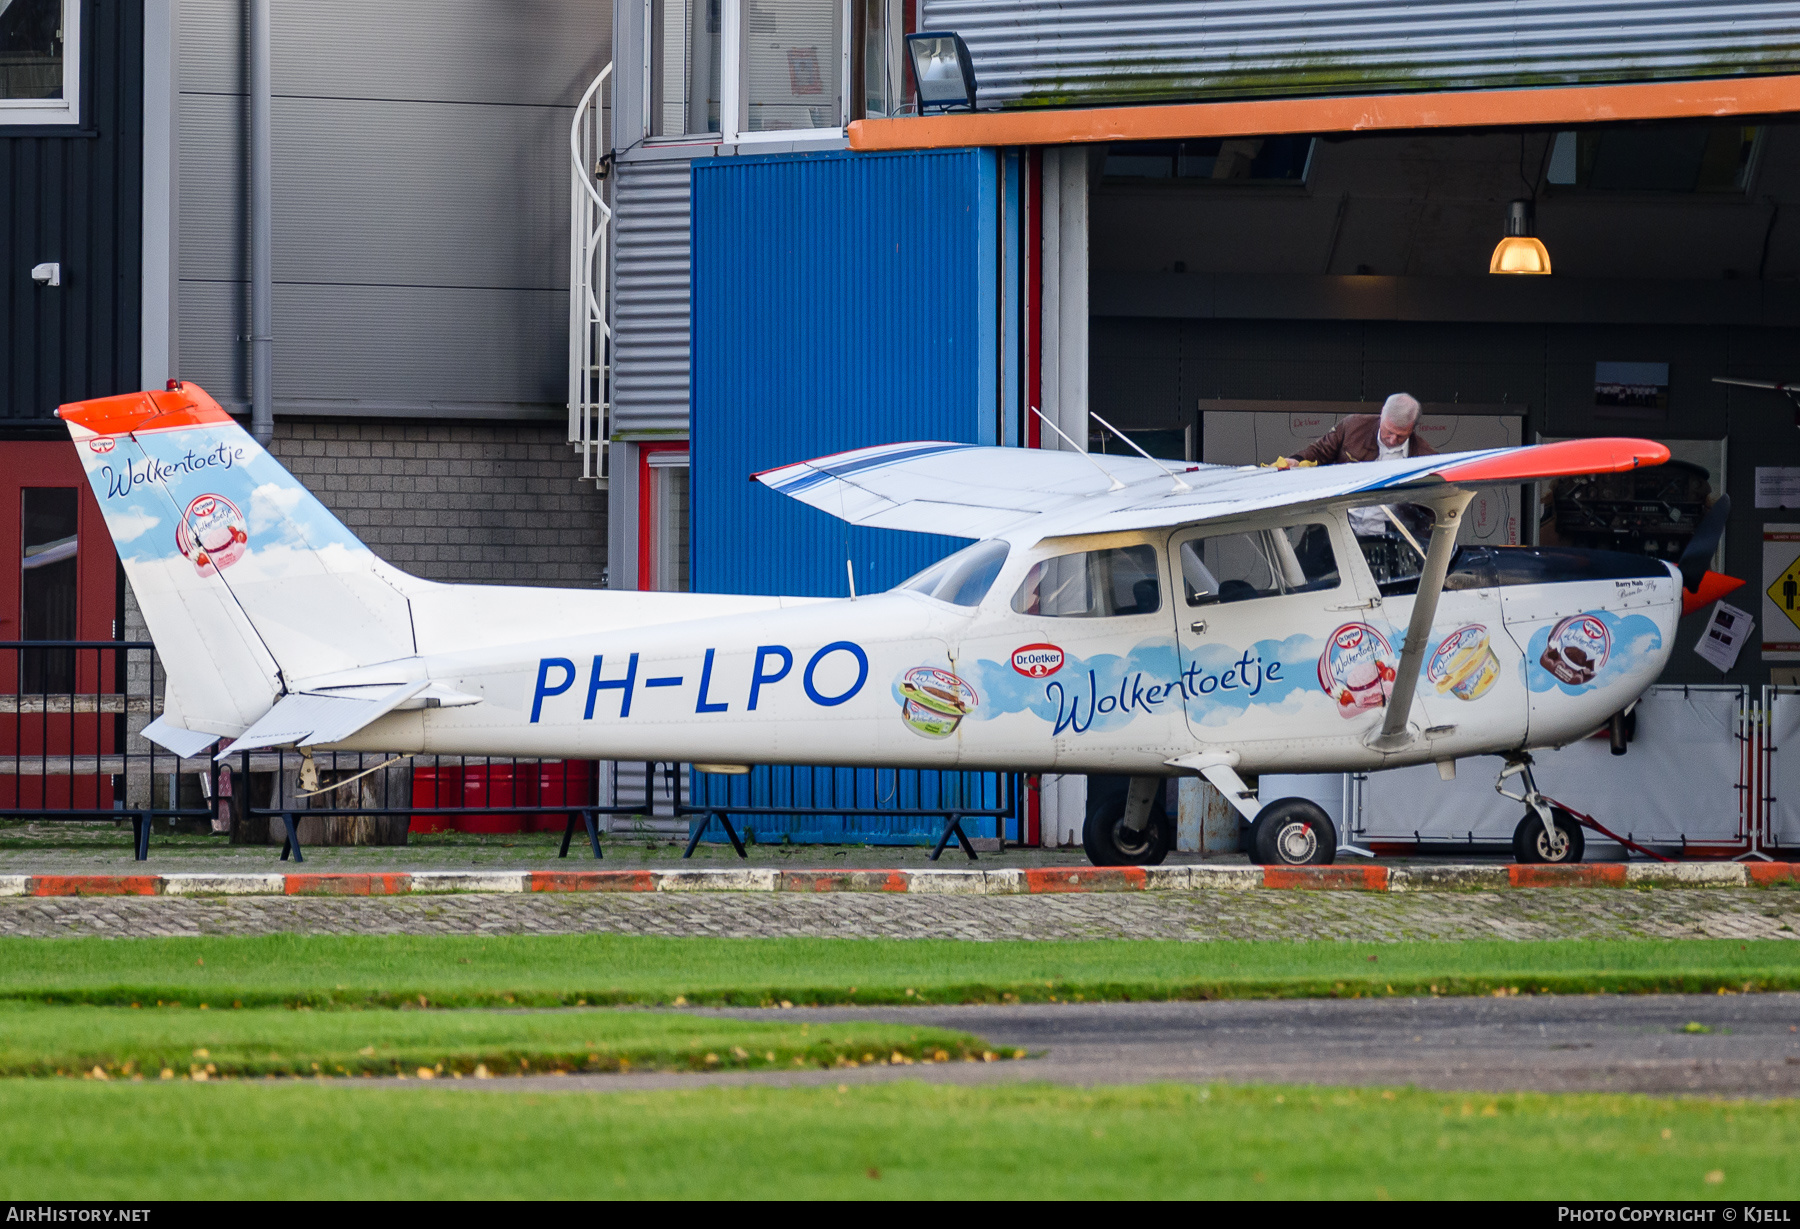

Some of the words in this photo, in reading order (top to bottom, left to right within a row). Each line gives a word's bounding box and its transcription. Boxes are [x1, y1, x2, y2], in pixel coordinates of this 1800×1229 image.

[101, 442, 246, 500] Wolkentoetje
[530, 641, 869, 723] PH-LPO
[1332, 639, 1381, 676] Wolkentoetje
[1046, 650, 1284, 737] Wolkentoetje
